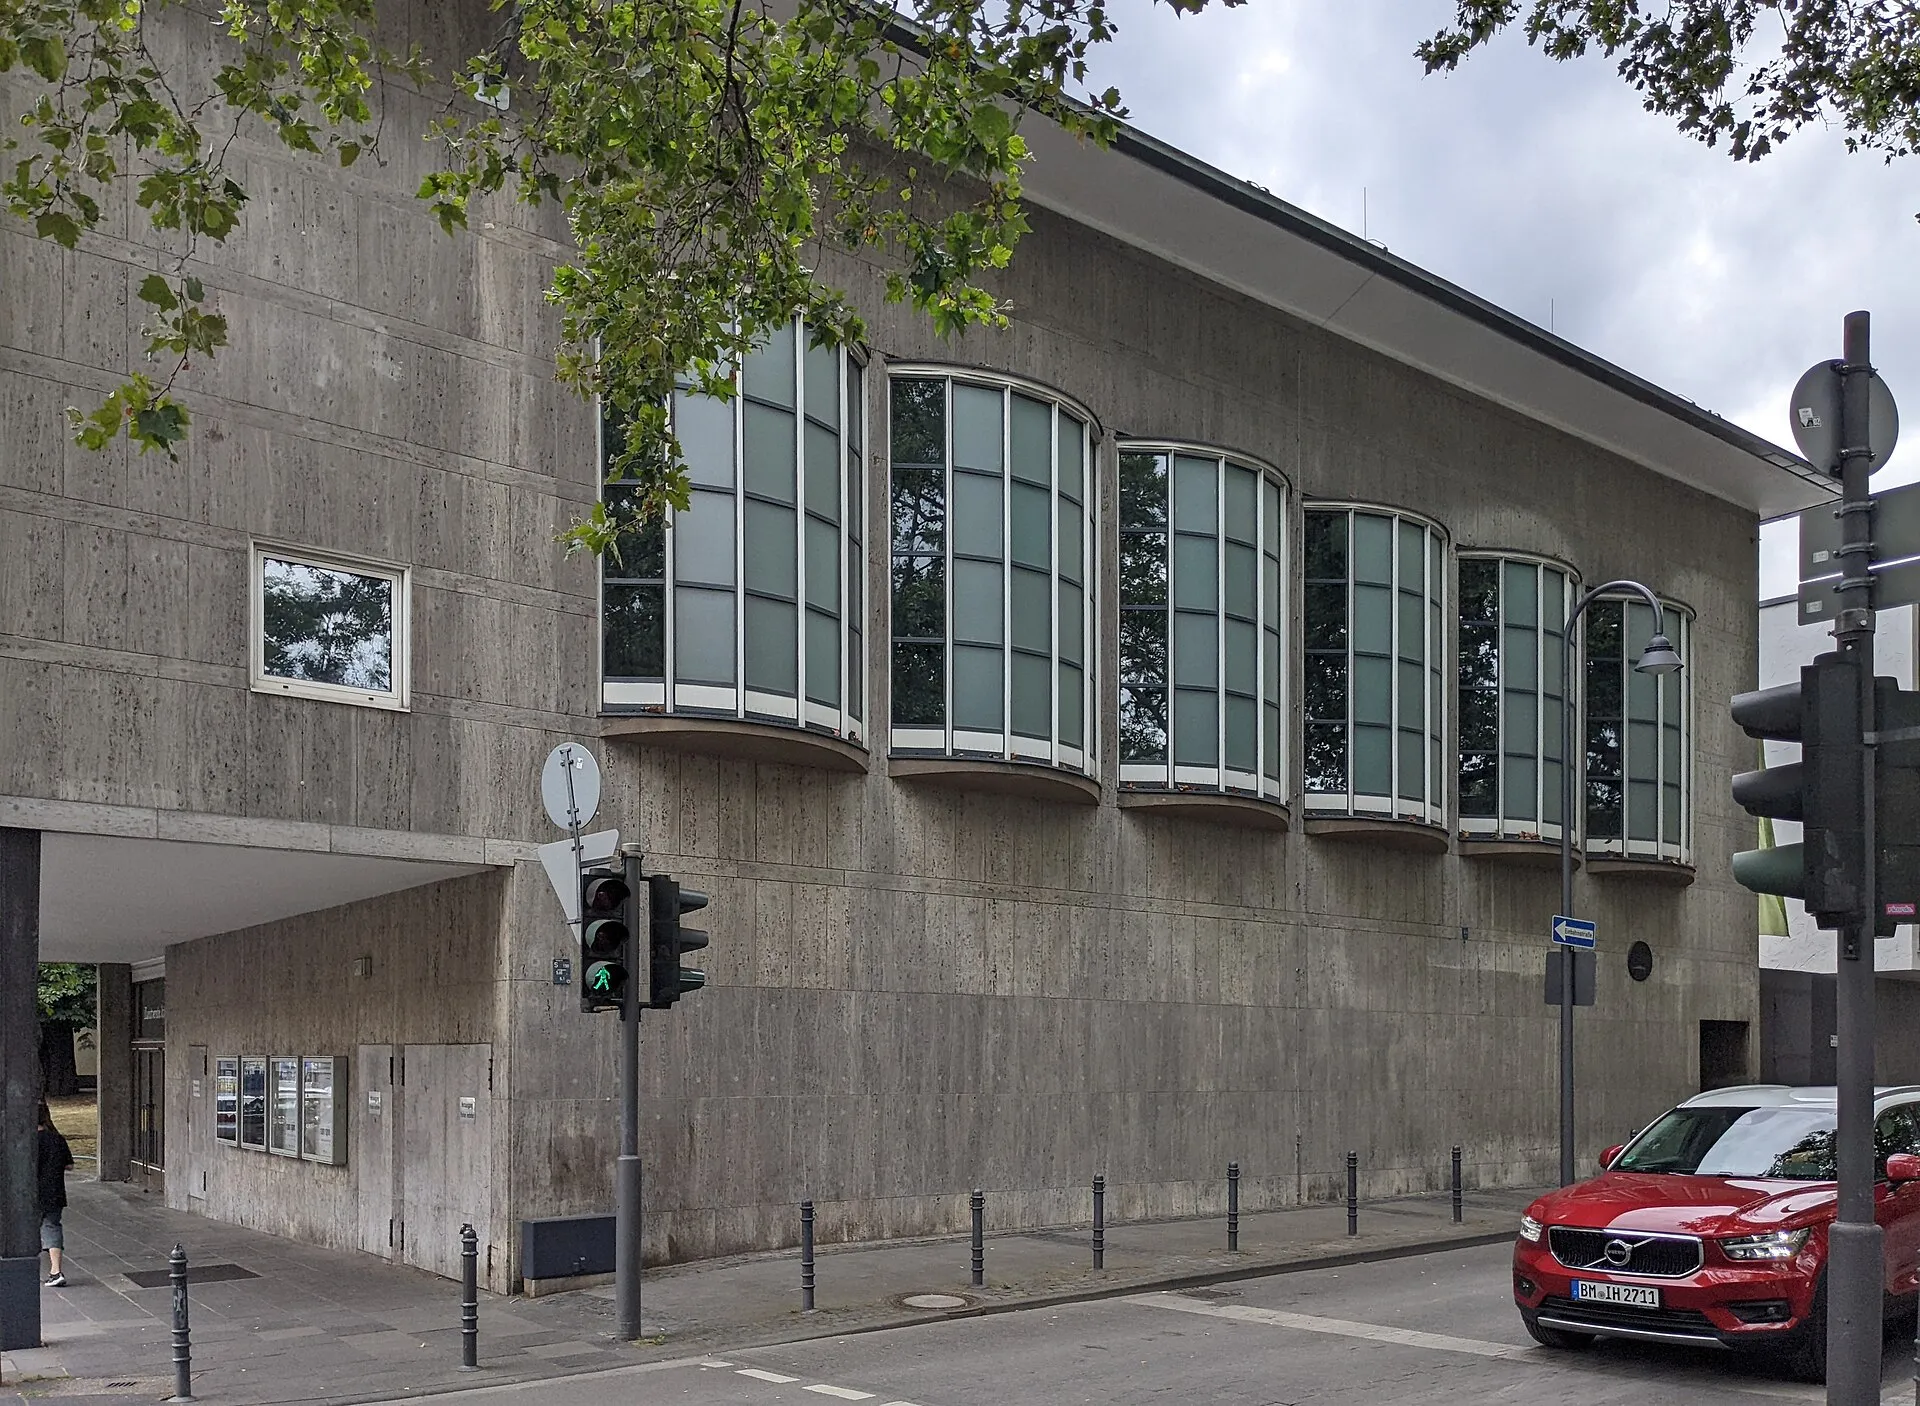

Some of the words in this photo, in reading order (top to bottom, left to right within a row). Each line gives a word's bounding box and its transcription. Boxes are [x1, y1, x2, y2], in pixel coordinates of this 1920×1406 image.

[1565, 928, 1593, 937] Einbahnstraße
[1580, 1284, 1596, 1298] BM
[1605, 1286, 1620, 1300] IH
[1623, 1288, 1656, 1304] 2711
